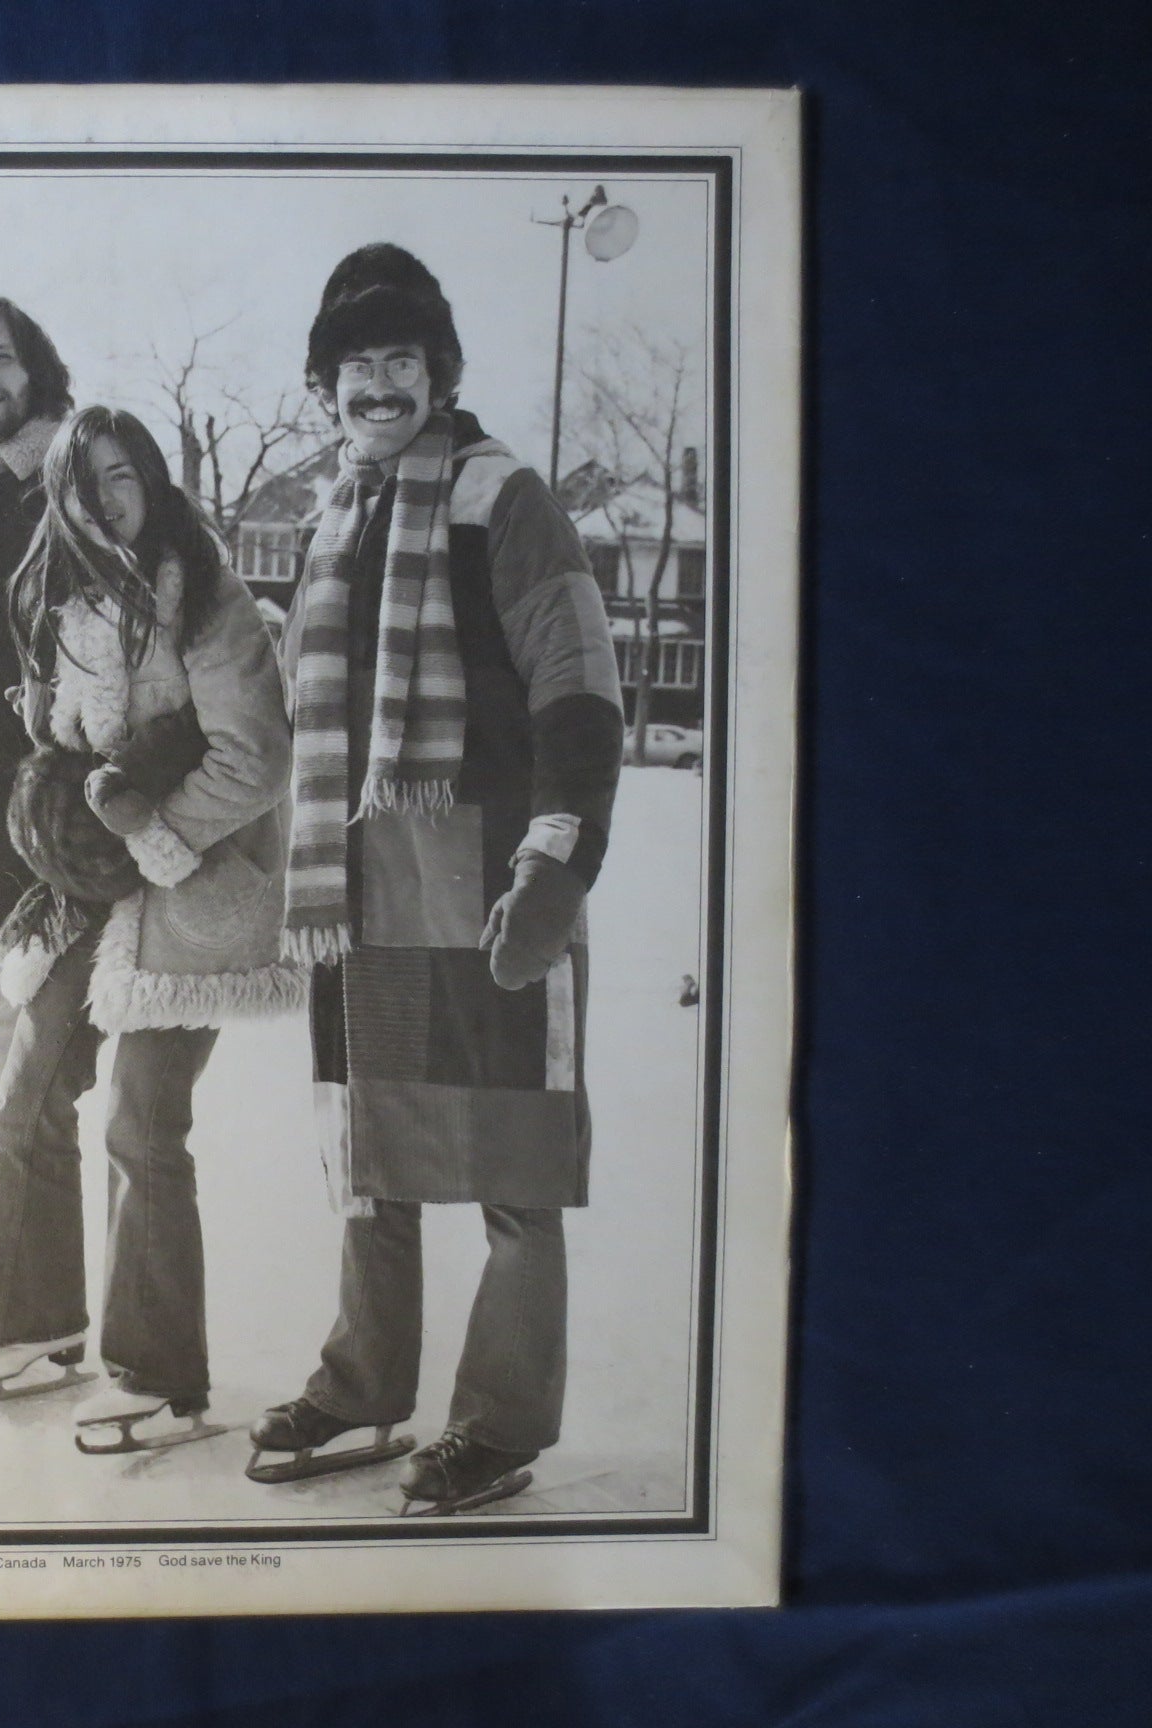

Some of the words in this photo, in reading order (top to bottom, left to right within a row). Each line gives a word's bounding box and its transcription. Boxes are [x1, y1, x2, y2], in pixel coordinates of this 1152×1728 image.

[62, 1555, 105, 1569] March
[109, 1554, 142, 1568] 1975
[158, 1553, 188, 1567] God
[190, 1556, 223, 1567] save
[224, 1554, 248, 1568] the
[250, 1552, 282, 1569] King
